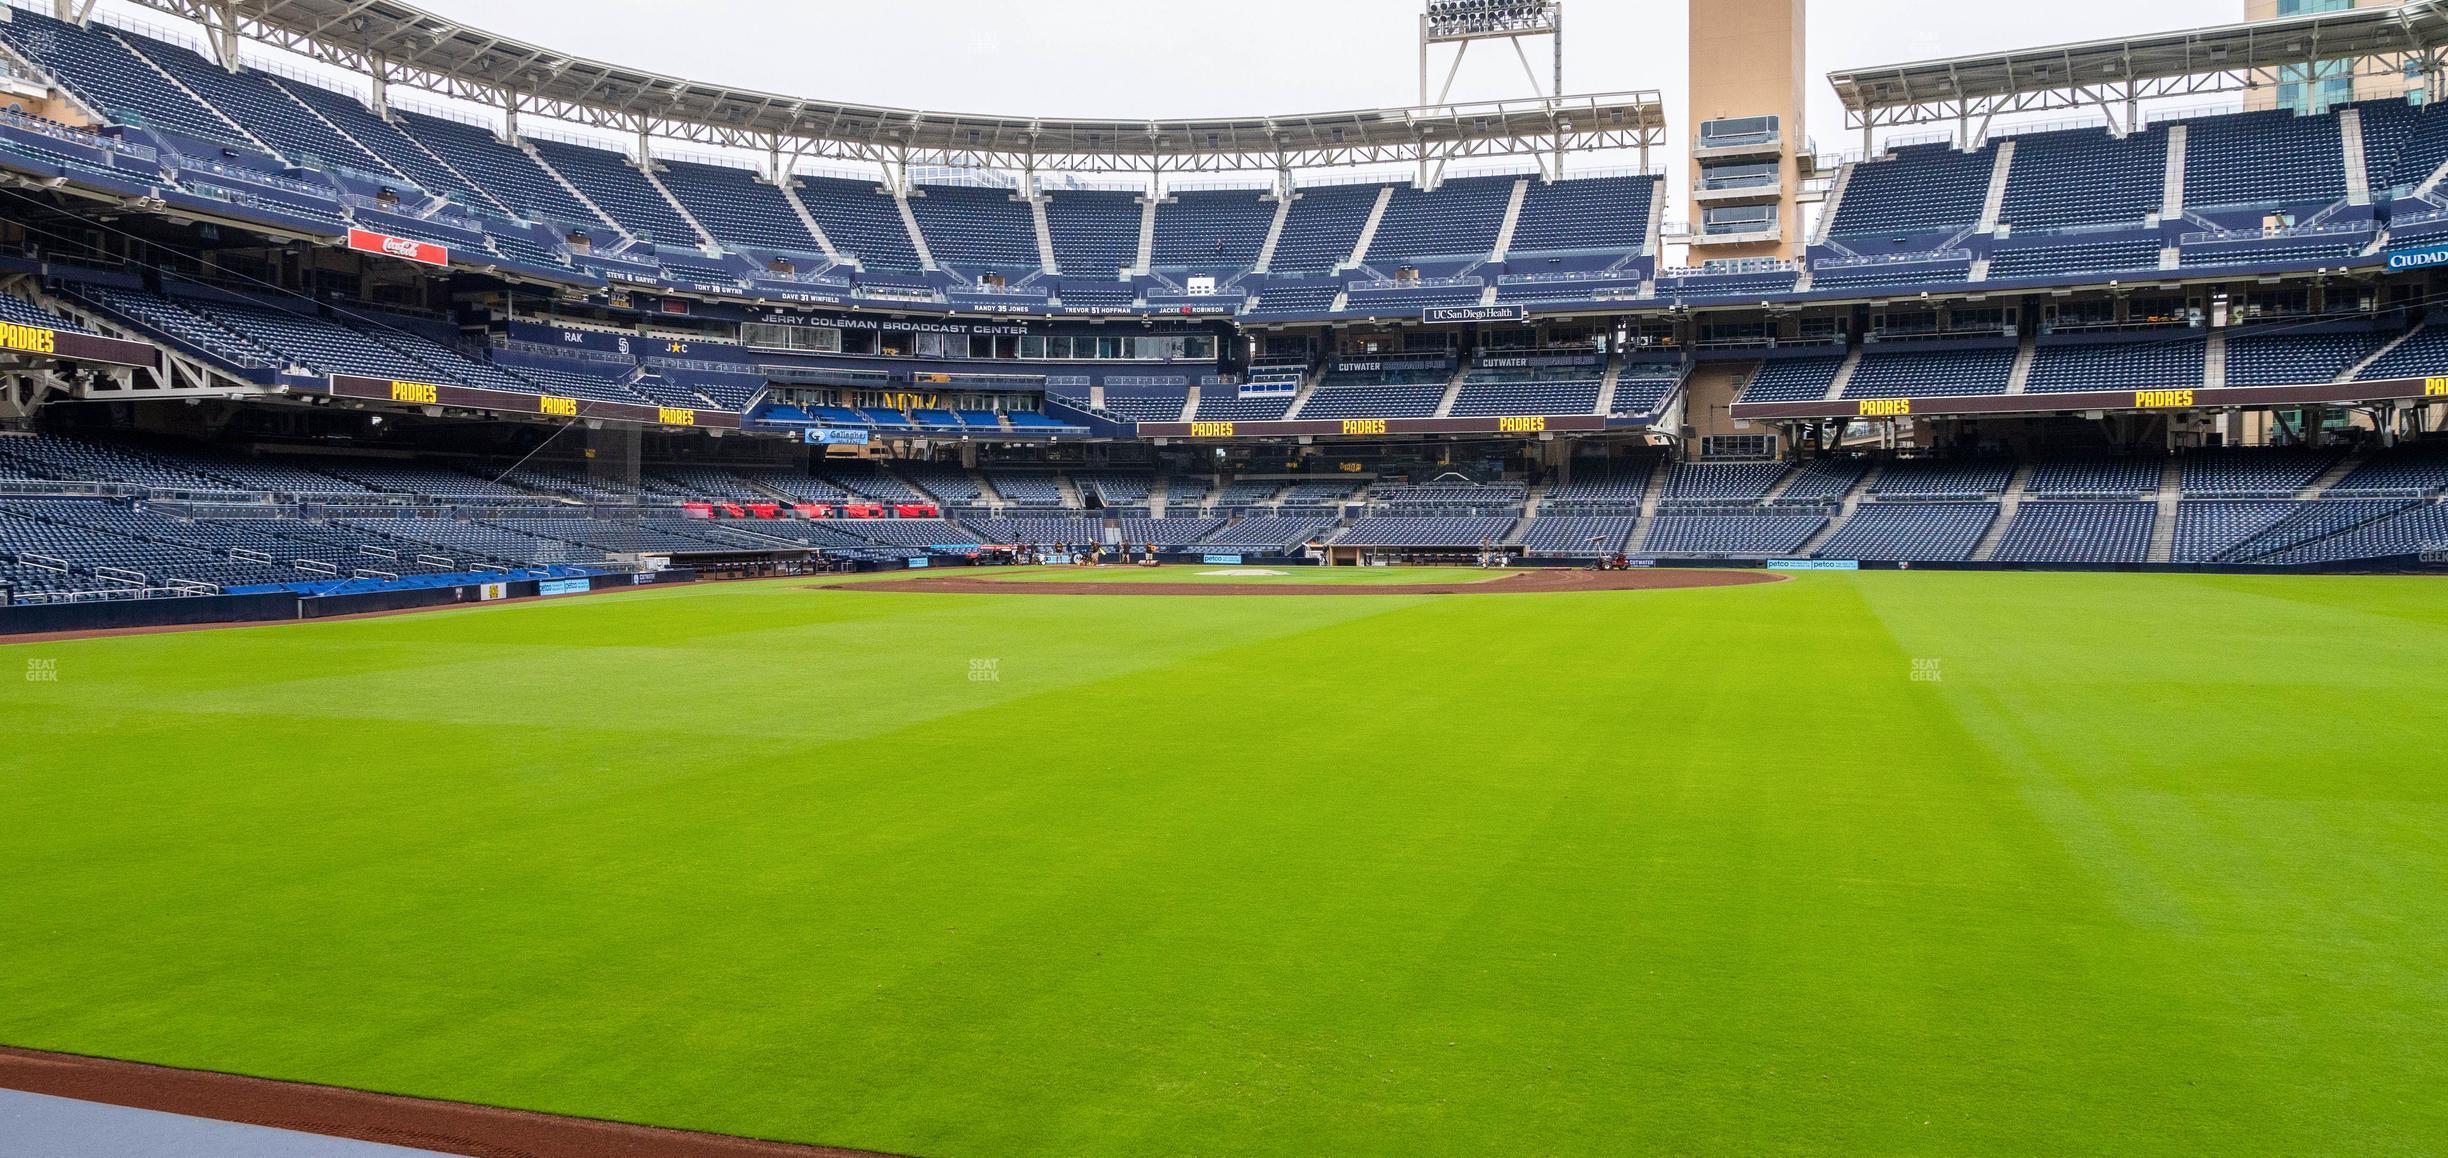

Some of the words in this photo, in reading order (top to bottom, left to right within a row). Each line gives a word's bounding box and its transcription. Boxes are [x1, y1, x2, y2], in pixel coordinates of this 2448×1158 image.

[2390, 252, 2448, 269] CIUDAD
[606, 271, 625, 280] STEVE
[627, 273, 633, 282] 6
[635, 275, 657, 285] GARVEY
[712, 285, 720, 293] 19
[721, 287, 743, 295] GWYNN
[782, 292, 799, 300] DAVE
[810, 295, 839, 303] WINFIELD
[1433, 310, 1447, 319] UC
[1447, 310, 1463, 319] San
[1463, 309, 1486, 319] Diego
[1486, 308, 1513, 318] Health
[761, 314, 805, 325] JERRY
[810, 317, 877, 329] COLEMAN
[883, 321, 968, 334] BROADCAST
[973, 325, 1028, 335] CENTER
[0, 322, 54, 353] PADRES
[564, 332, 583, 343] RAK
[1338, 362, 1381, 371] CUTWATER
[1482, 358, 1527, 367] CUTWATER
[391, 380, 437, 404] PADRES
[2425, 377, 2448, 396] PA
[540, 396, 577, 416] PADRES
[2135, 390, 2193, 408] PADRES
[1859, 399, 1910, 416] PADRES
[658, 407, 694, 425] PADRES
[1500, 416, 1545, 431] PADRES
[1191, 422, 1233, 437] PADRES
[1342, 420, 1385, 434] PADRES
